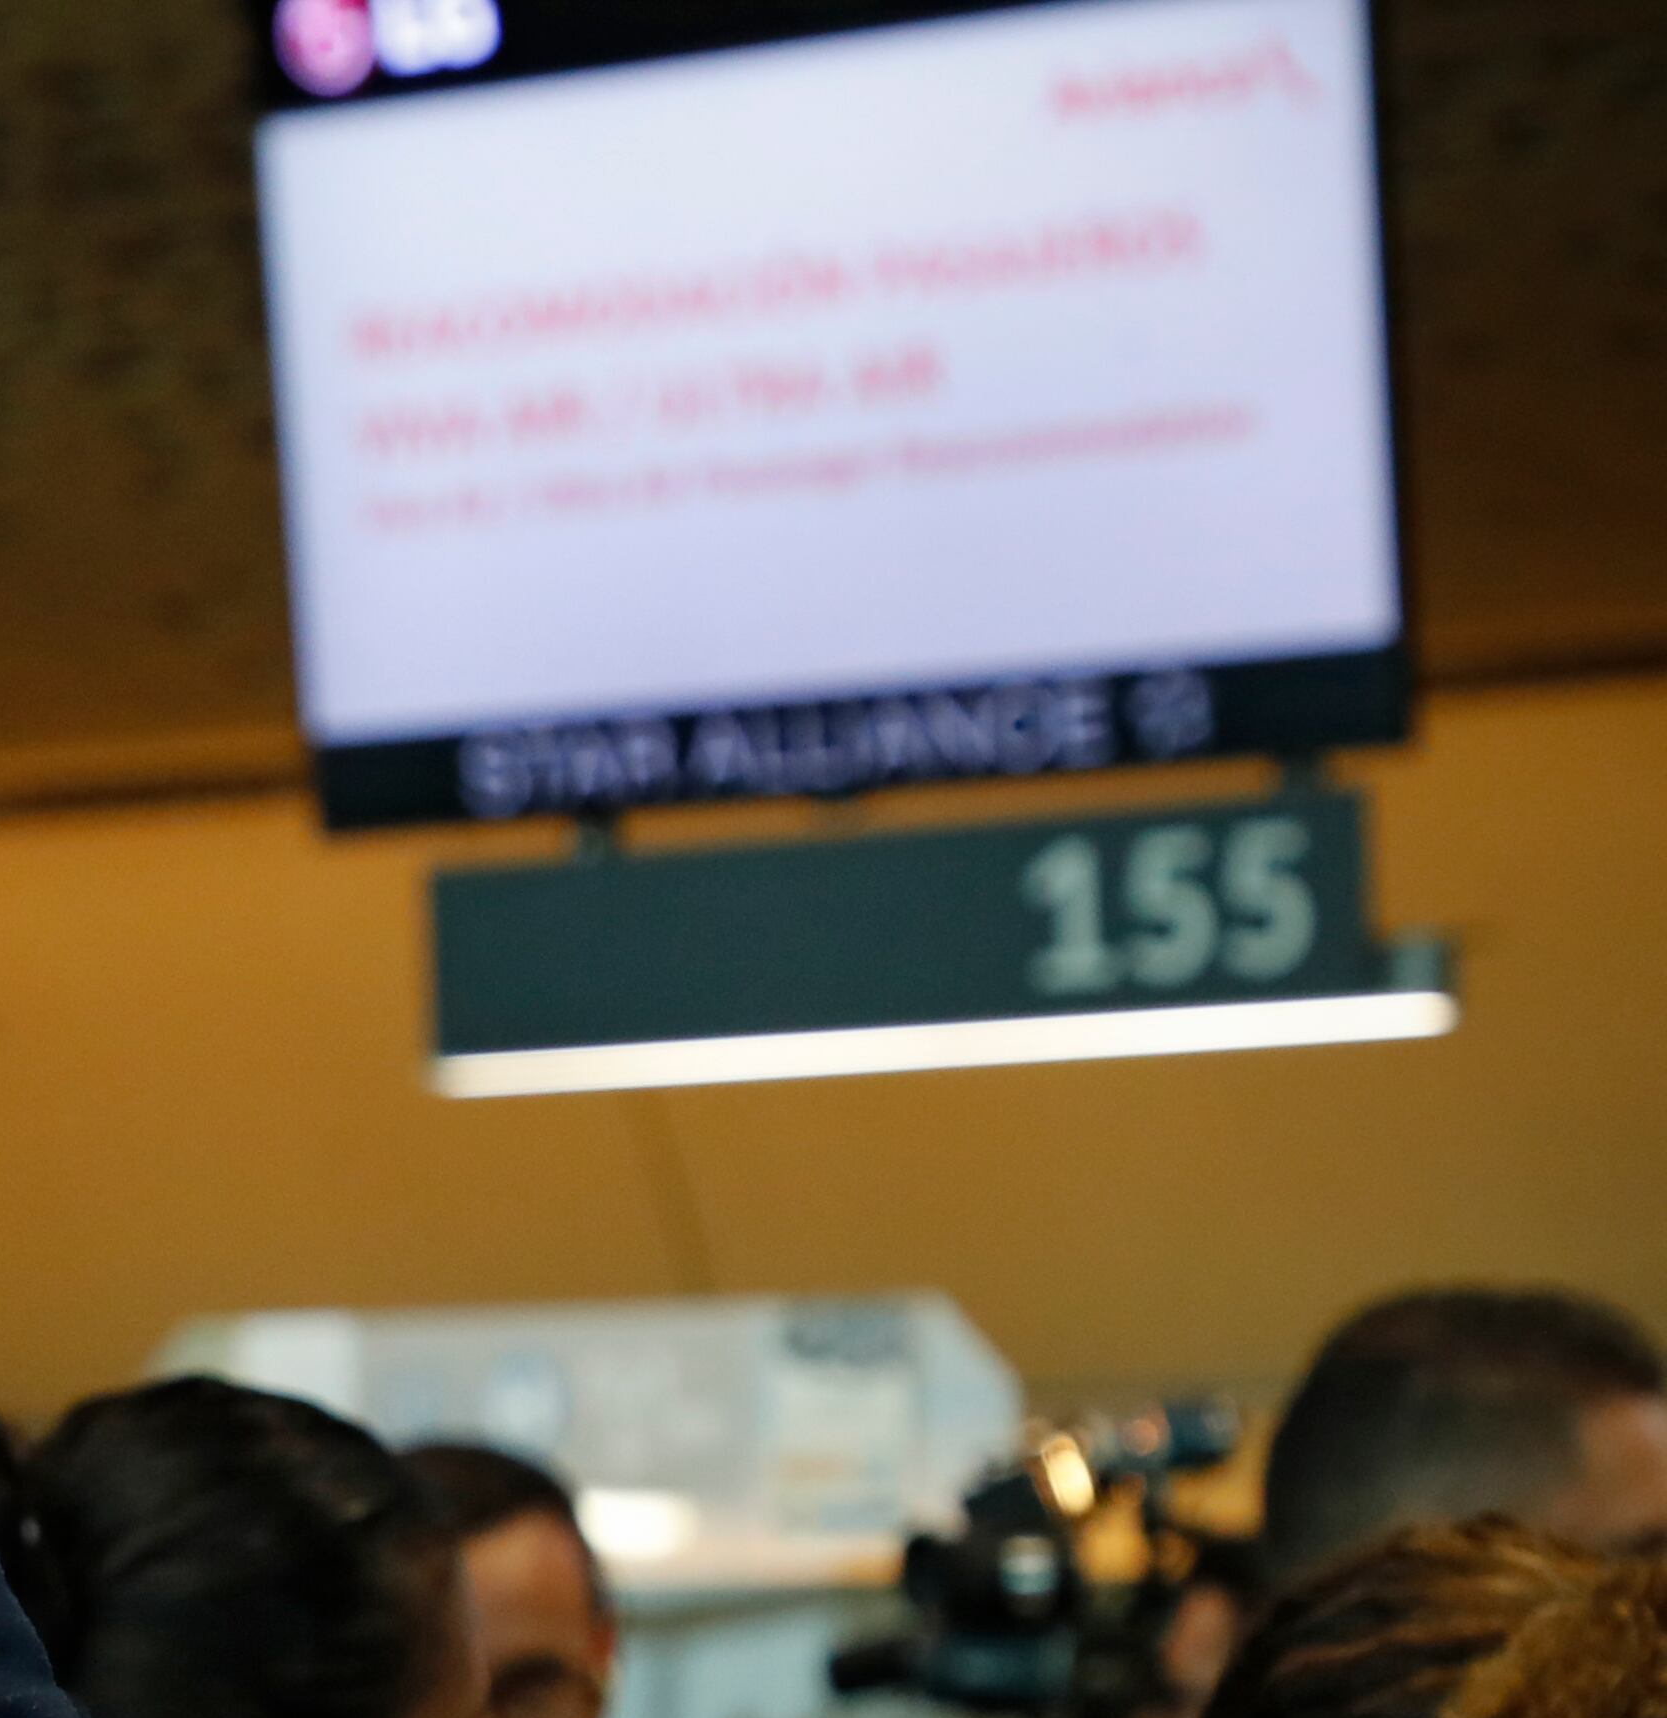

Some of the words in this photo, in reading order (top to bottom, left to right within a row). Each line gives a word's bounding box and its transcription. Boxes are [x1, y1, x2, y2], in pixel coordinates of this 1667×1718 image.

[462, 711, 676, 817] STAR
[687, 677, 1115, 796] ALLIANCE
[1020, 815, 1317, 995] 155
